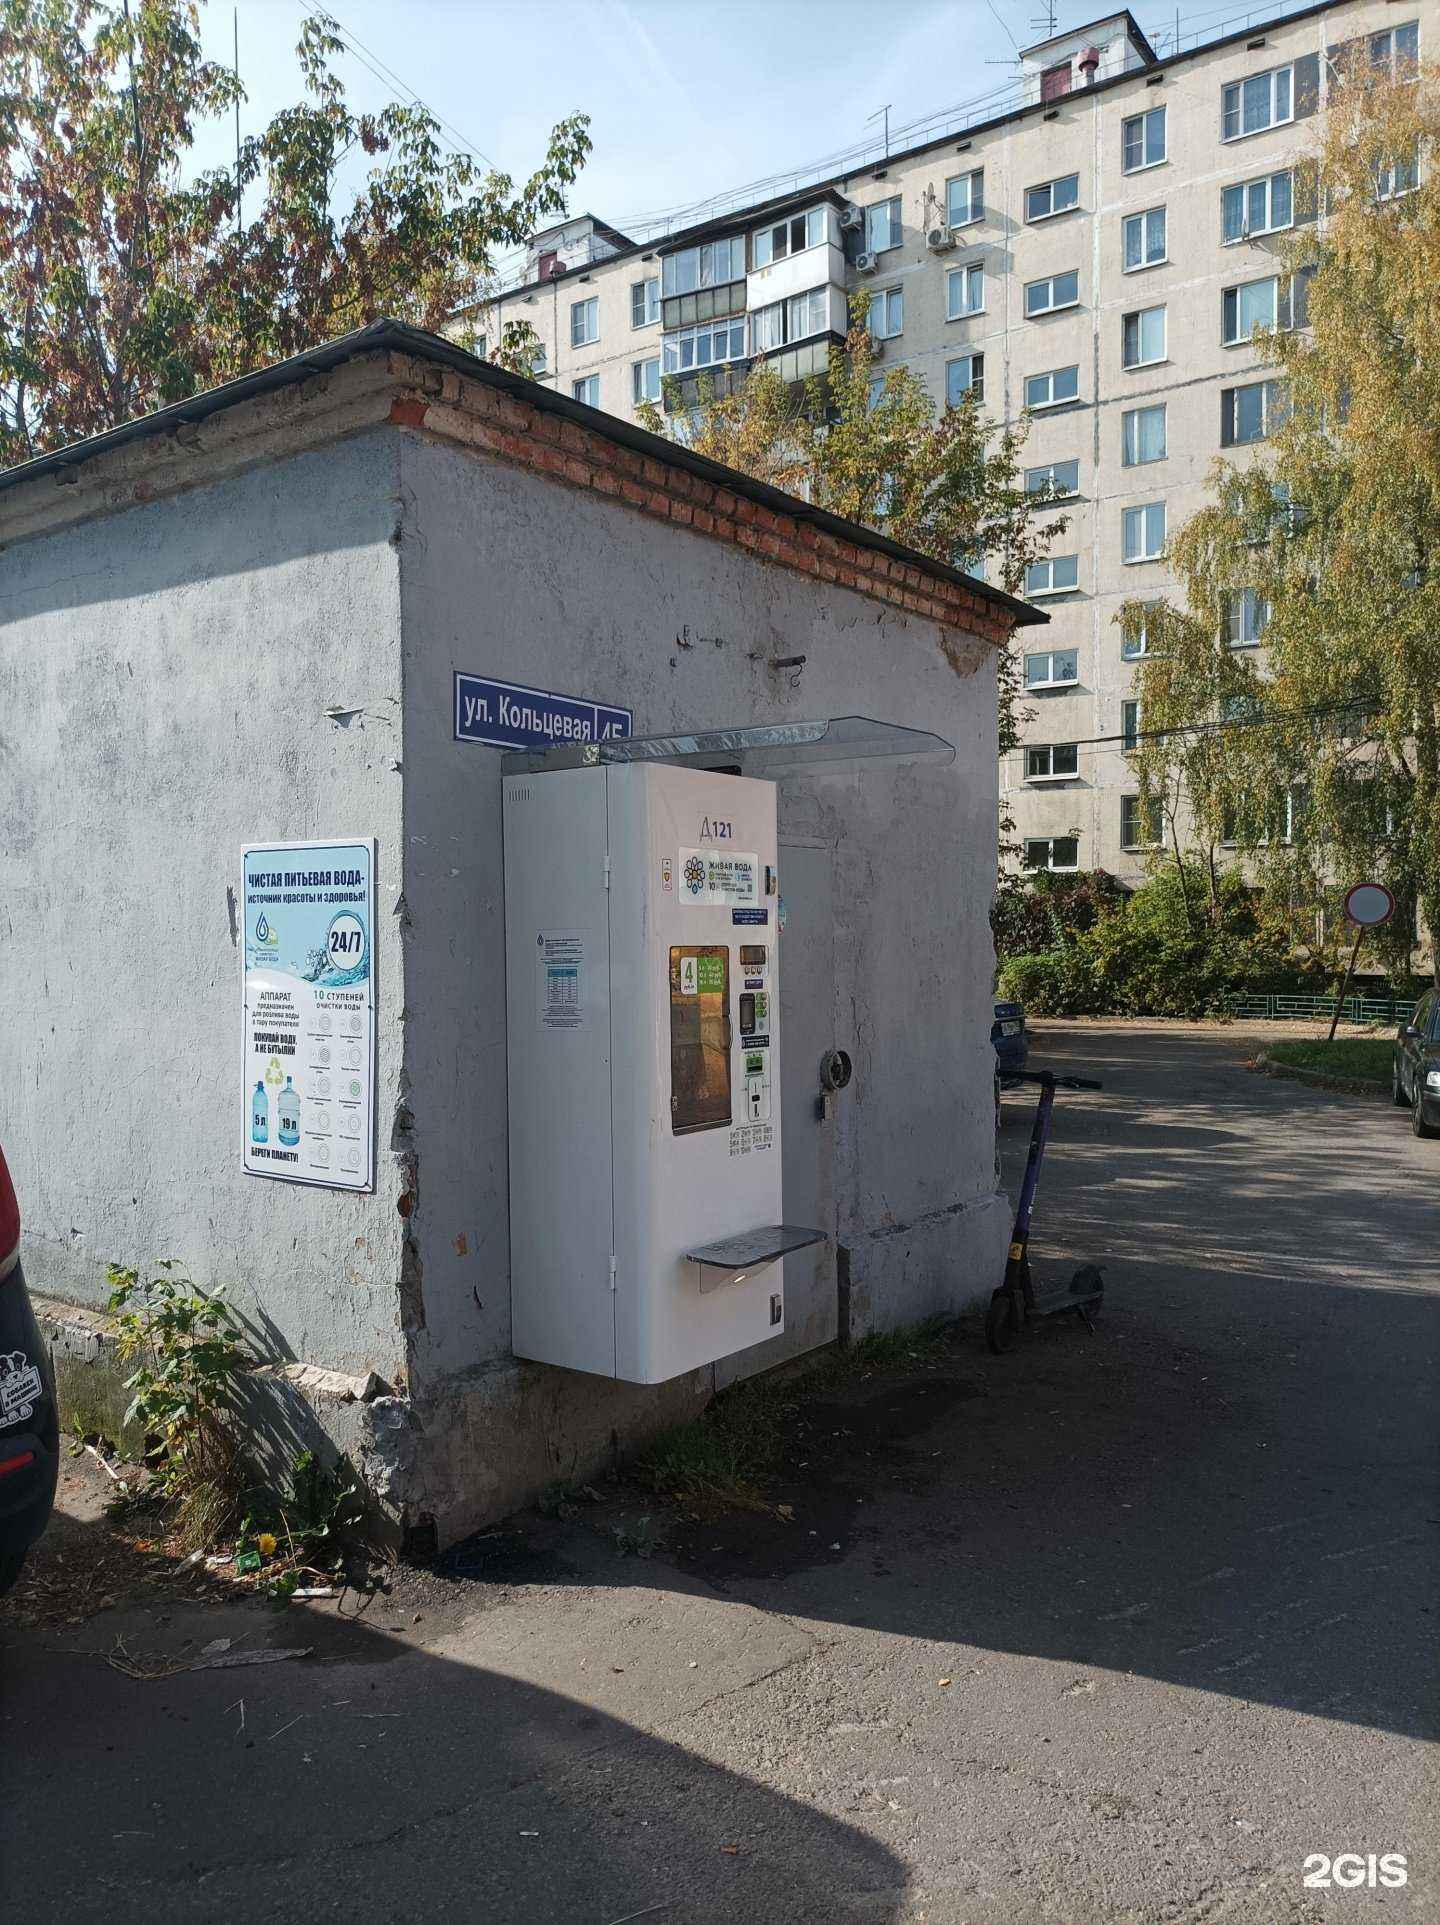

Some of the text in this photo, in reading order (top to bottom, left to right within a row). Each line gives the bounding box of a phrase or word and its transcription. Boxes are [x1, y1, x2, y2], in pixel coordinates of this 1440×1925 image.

[464, 695, 493, 727] ул.
[499, 695, 591, 740] Кольцевая
[708, 861, 752, 871] ЖИВАЯ ВОДА
[248, 870, 365, 888] ЧИСТАЯ ПИТЬЕВАЯ ВОДА-
[330, 931, 361, 953] 24/7
[260, 991, 291, 1001] АППАРАТ
[314, 990, 364, 1001] 10 СТУПЕНЕЙ
[254, 1032, 297, 1045] ПОКУПАЙ ВОДУ,
[254, 1043, 296, 1055] А НЕ БУТЫЛКИ
[255, 1115, 260, 1126] 5
[282, 1118, 297, 1130] 19 л
[251, 1146, 299, 1163] БЕРЕГИ ПЛАНЕТУ!
